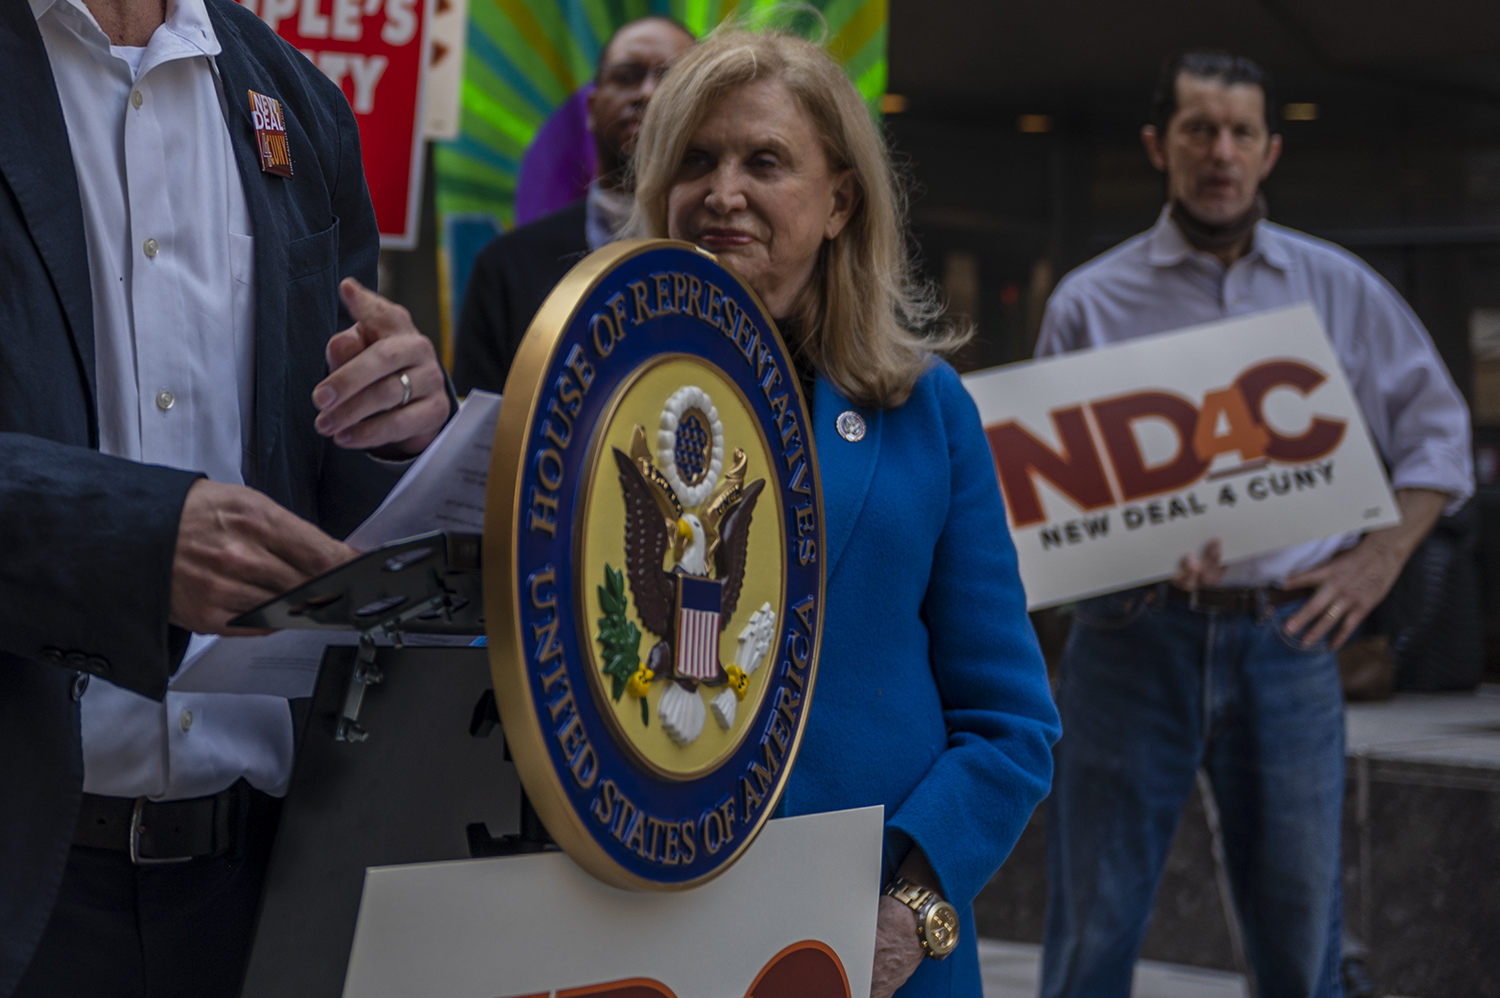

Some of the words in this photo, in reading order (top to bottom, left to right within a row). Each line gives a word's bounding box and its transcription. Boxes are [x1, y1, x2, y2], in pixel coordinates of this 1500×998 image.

[251, 110, 284, 131] DEAL
[252, 93, 278, 114] NEW
[528, 344, 596, 539] HOUSE
[591, 292, 628, 358] OF
[629, 271, 816, 567] REPRESENTATIVES
[1039, 516, 1110, 550] NEW
[1122, 492, 1207, 532] DEAL
[1217, 483, 1237, 508] 4
[1247, 461, 1335, 502] CUNY
[530, 567, 599, 790] UNITED
[594, 778, 697, 865] STATES
[703, 795, 736, 854] OF
[740, 595, 816, 824] AMERICA
